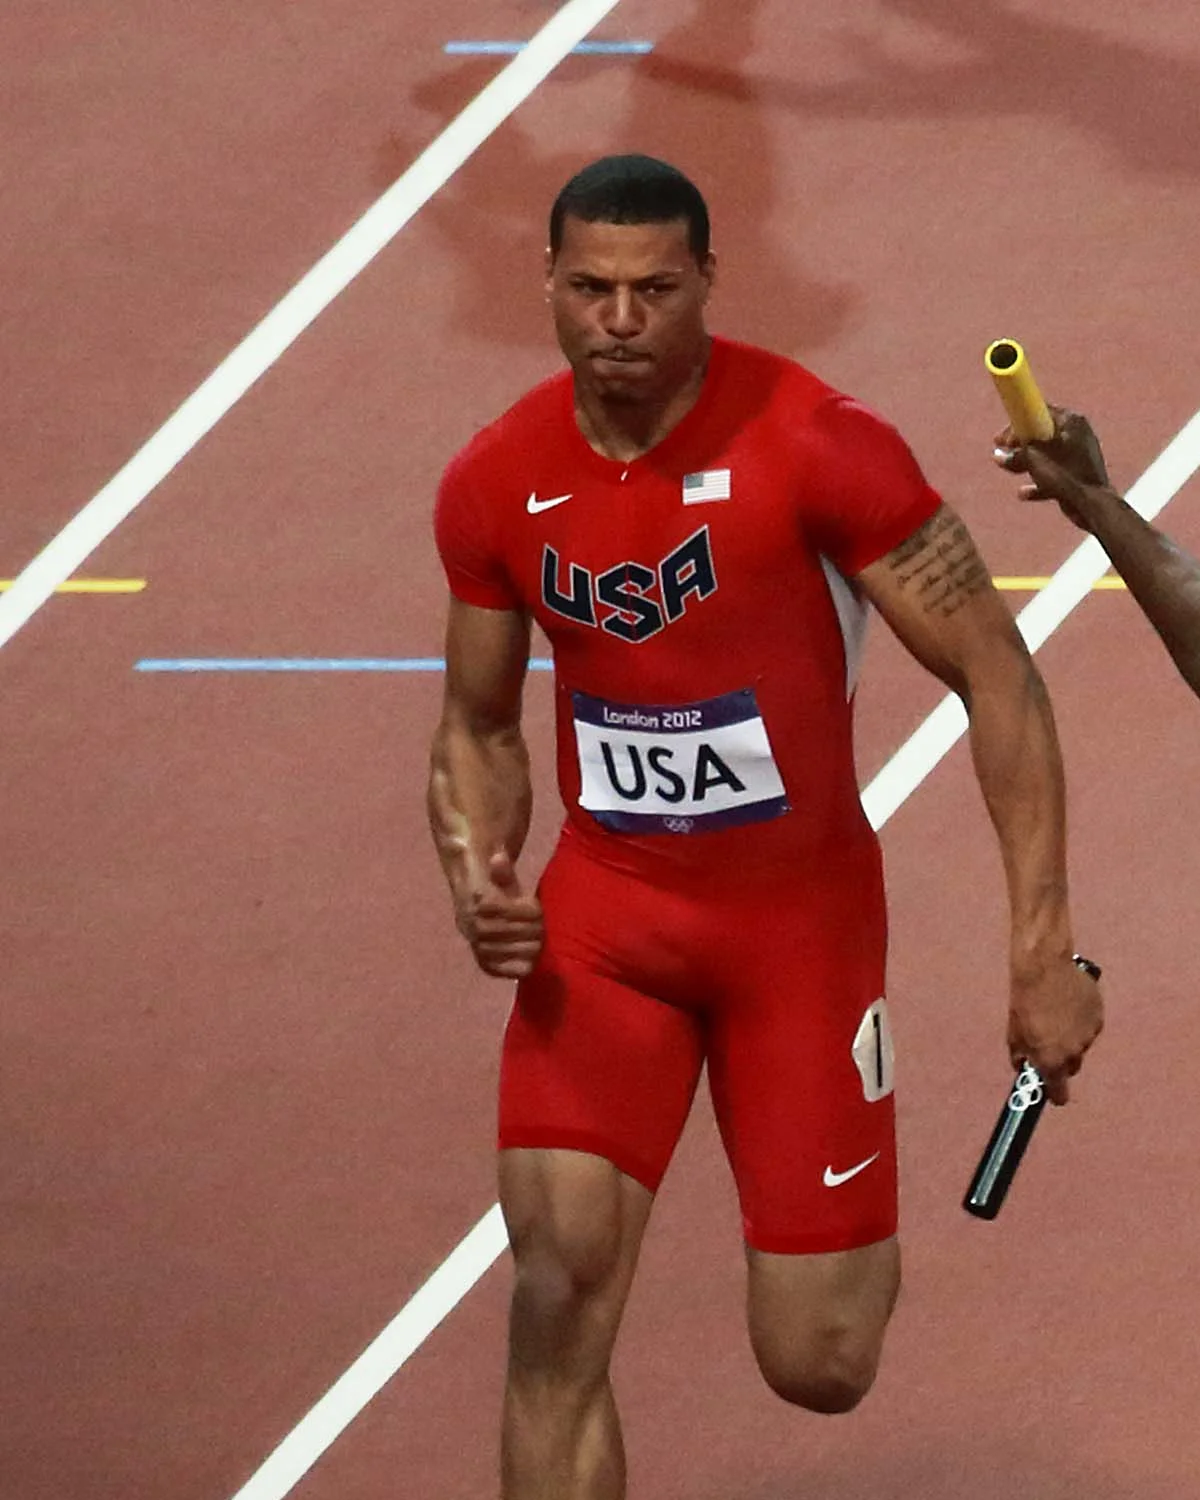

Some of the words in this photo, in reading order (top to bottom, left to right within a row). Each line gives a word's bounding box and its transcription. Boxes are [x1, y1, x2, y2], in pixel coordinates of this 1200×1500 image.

[541, 524, 718, 644] USA
[603, 706, 659, 729] London
[662, 710, 702, 729] 2012
[600, 741, 747, 803] USA
